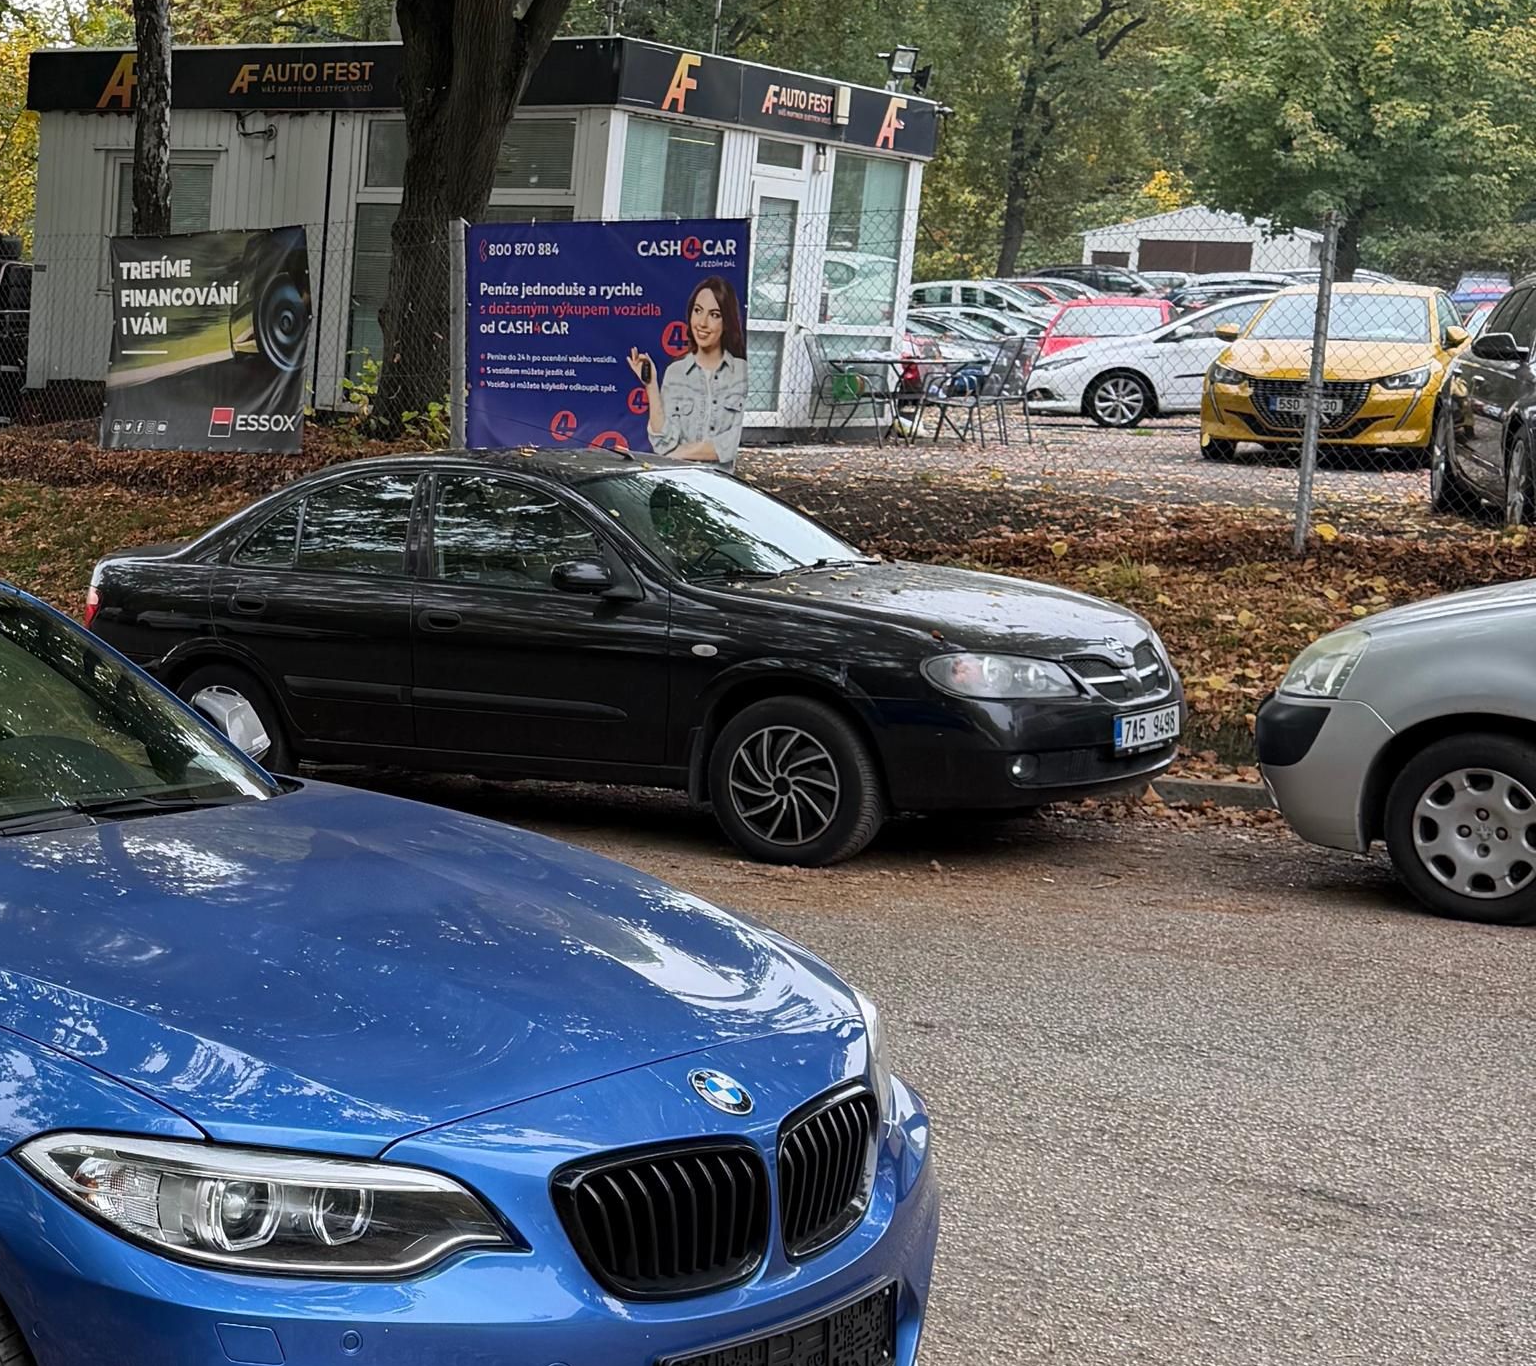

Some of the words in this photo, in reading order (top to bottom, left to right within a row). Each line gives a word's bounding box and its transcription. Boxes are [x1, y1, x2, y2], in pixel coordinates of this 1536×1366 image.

[262, 62, 317, 81] AUTO
[323, 61, 374, 80] FEST
[779, 87, 807, 109] AUTO
[808, 92, 834, 114] FEST
[489, 243, 512, 256] 800
[514, 243, 536, 256] 870
[537, 242, 559, 256] 884
[119, 255, 192, 280] TREFÍME
[120, 281, 240, 308] FINANCOVÁNÍ
[480, 282, 519, 296] Peníze
[521, 283, 586, 299] jednoduše
[588, 287, 596, 296] a
[600, 284, 643, 300] rychle
[480, 305, 486, 314] s
[488, 301, 549, 318] dočasným
[551, 302, 610, 319] výkupem
[614, 303, 661, 317] vozidla
[122, 317, 128, 335] I
[129, 312, 167, 335] VÁM
[480, 321, 495, 334] od
[498, 320, 569, 335] CASH4CAR
[517, 353, 526, 361] 24
[526, 354, 531, 362] h
[532, 355, 541, 363] po
[568, 354, 592, 363] vašeho
[235, 414, 296, 432] ESSOX
[1124, 717, 1147, 744] 7A5
[1153, 710, 1175, 737] 9498
